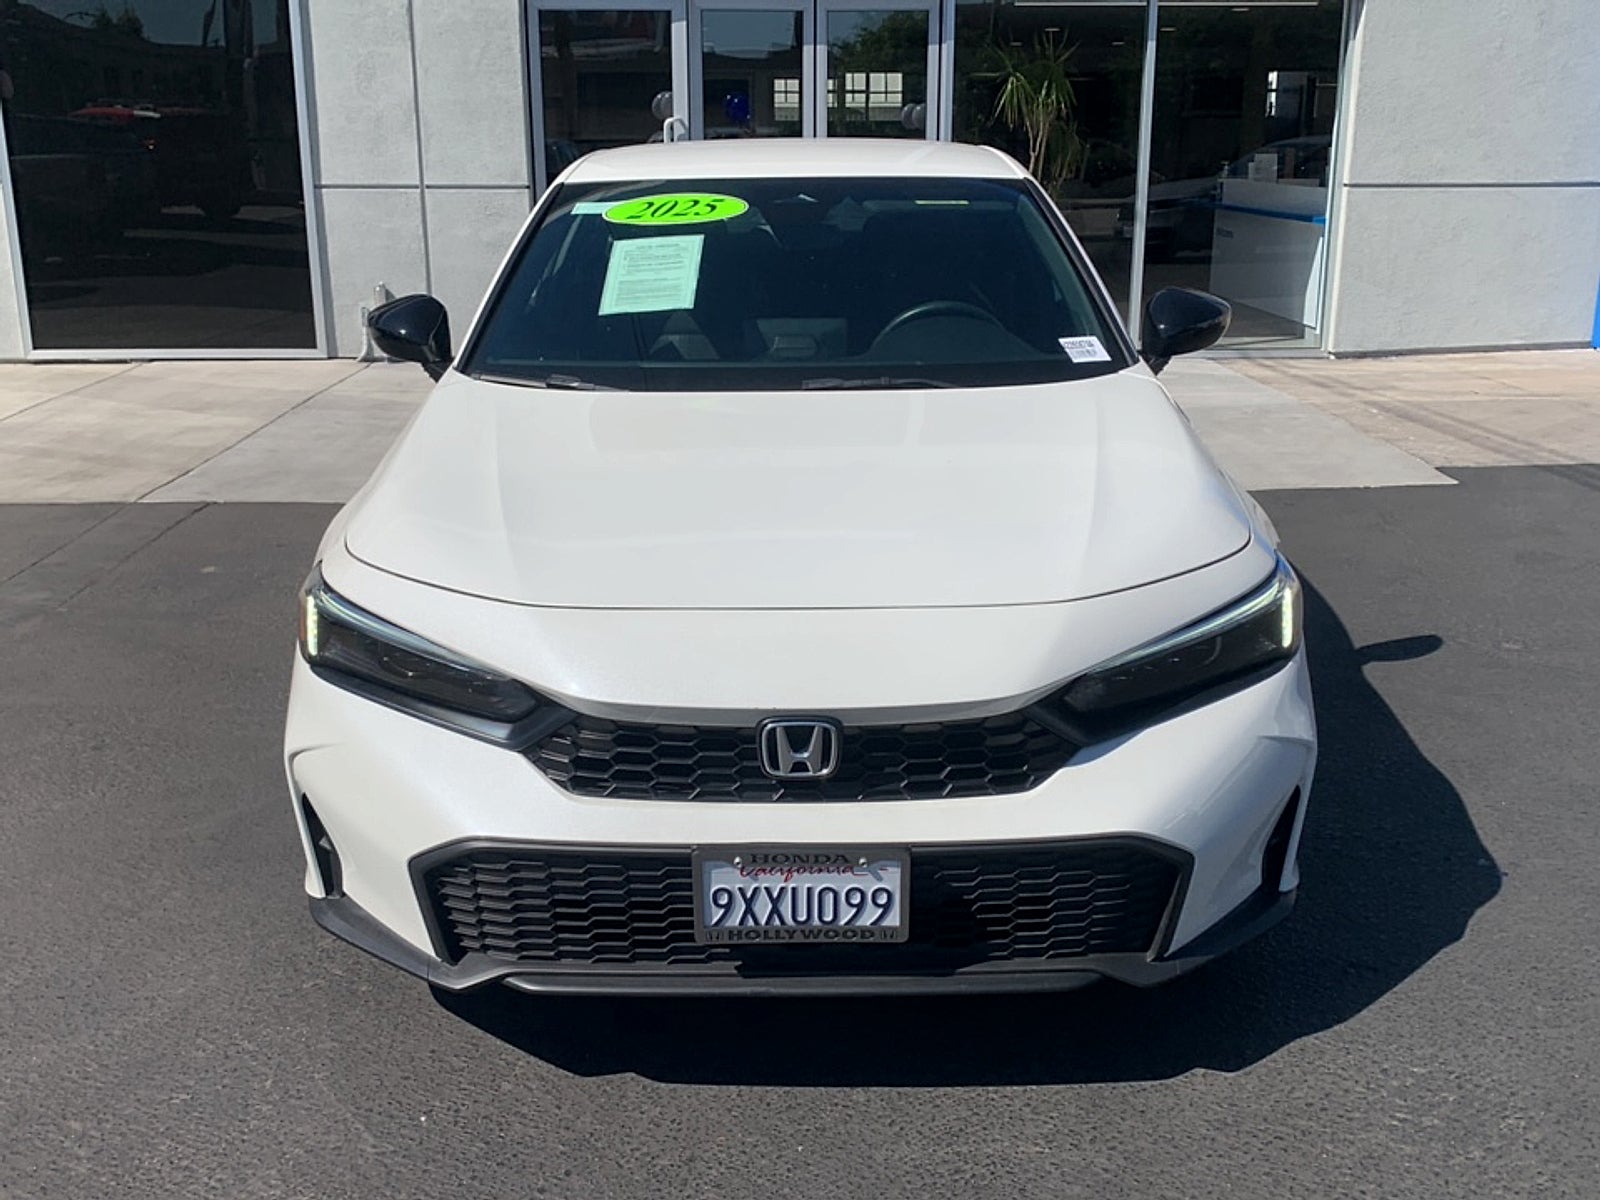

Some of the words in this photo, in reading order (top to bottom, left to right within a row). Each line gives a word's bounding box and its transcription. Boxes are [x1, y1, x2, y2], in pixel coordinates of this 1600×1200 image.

[626, 198, 726, 220] 2025
[750, 853, 850, 865] HONDA
[711, 885, 894, 927] 9XXU099
[728, 928, 876, 942] HOLLYWOOD
